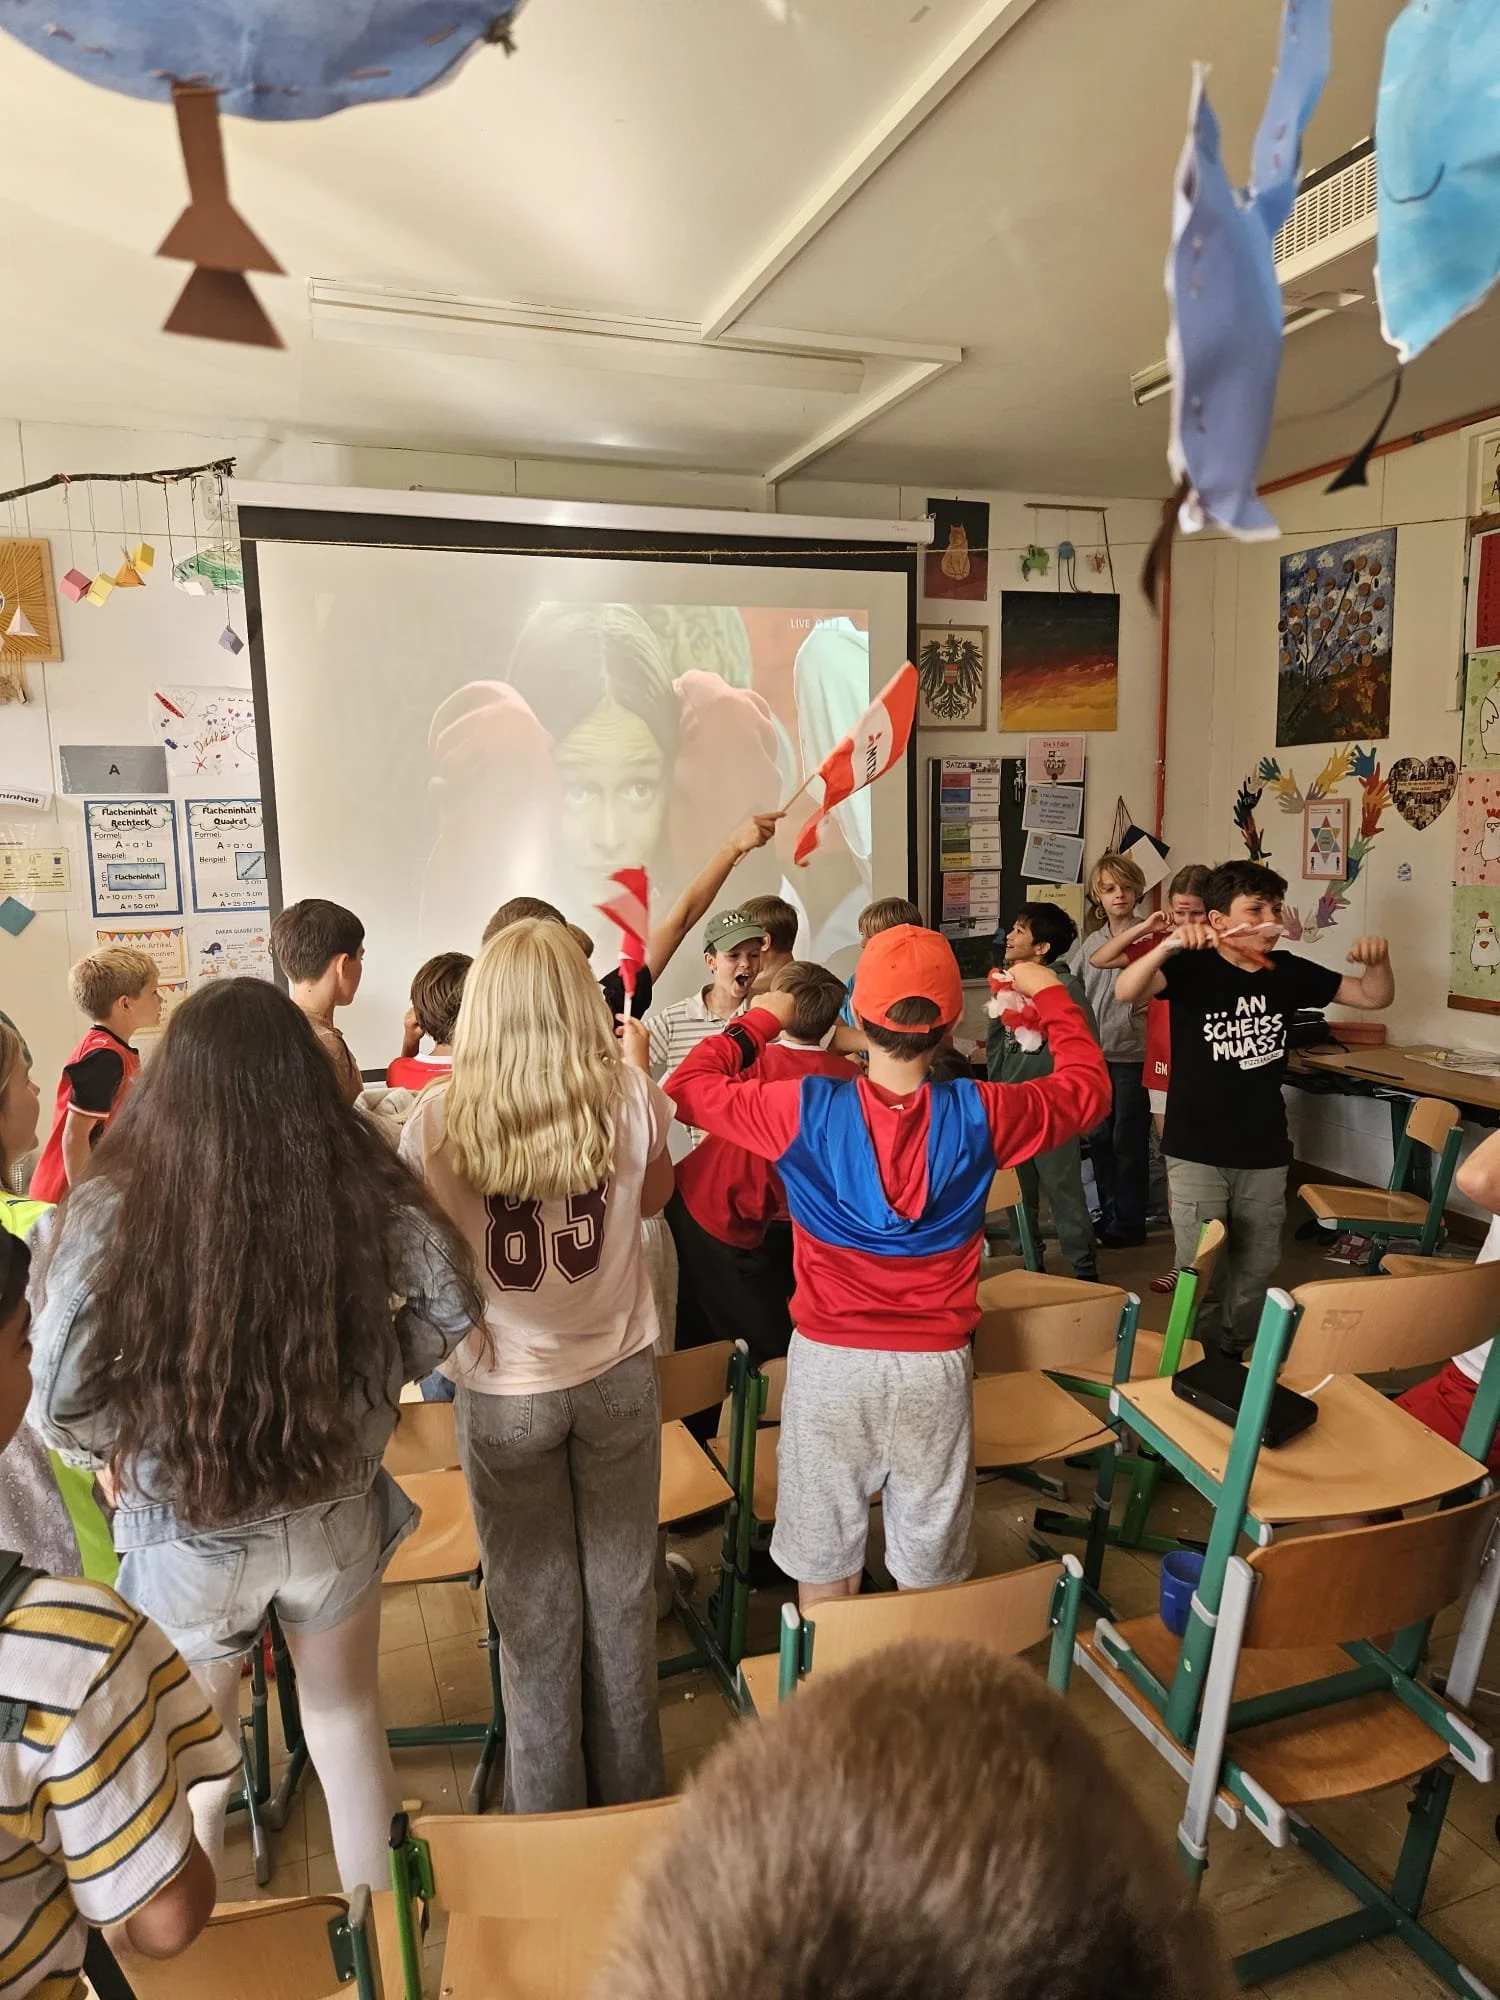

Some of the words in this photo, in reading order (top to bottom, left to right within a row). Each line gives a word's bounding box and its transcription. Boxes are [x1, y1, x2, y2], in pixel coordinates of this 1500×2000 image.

[790, 617, 810, 629] LIVE
[108, 764, 120, 775] A
[111, 818, 151, 828] Rechteck
[213, 818, 248, 826] Quadrat
[115, 840, 123, 849] A
[146, 840, 153, 848] b
[217, 841, 224, 849] A
[1235, 994, 1266, 1017] AN
[1203, 1013, 1283, 1042] SCHEISS
